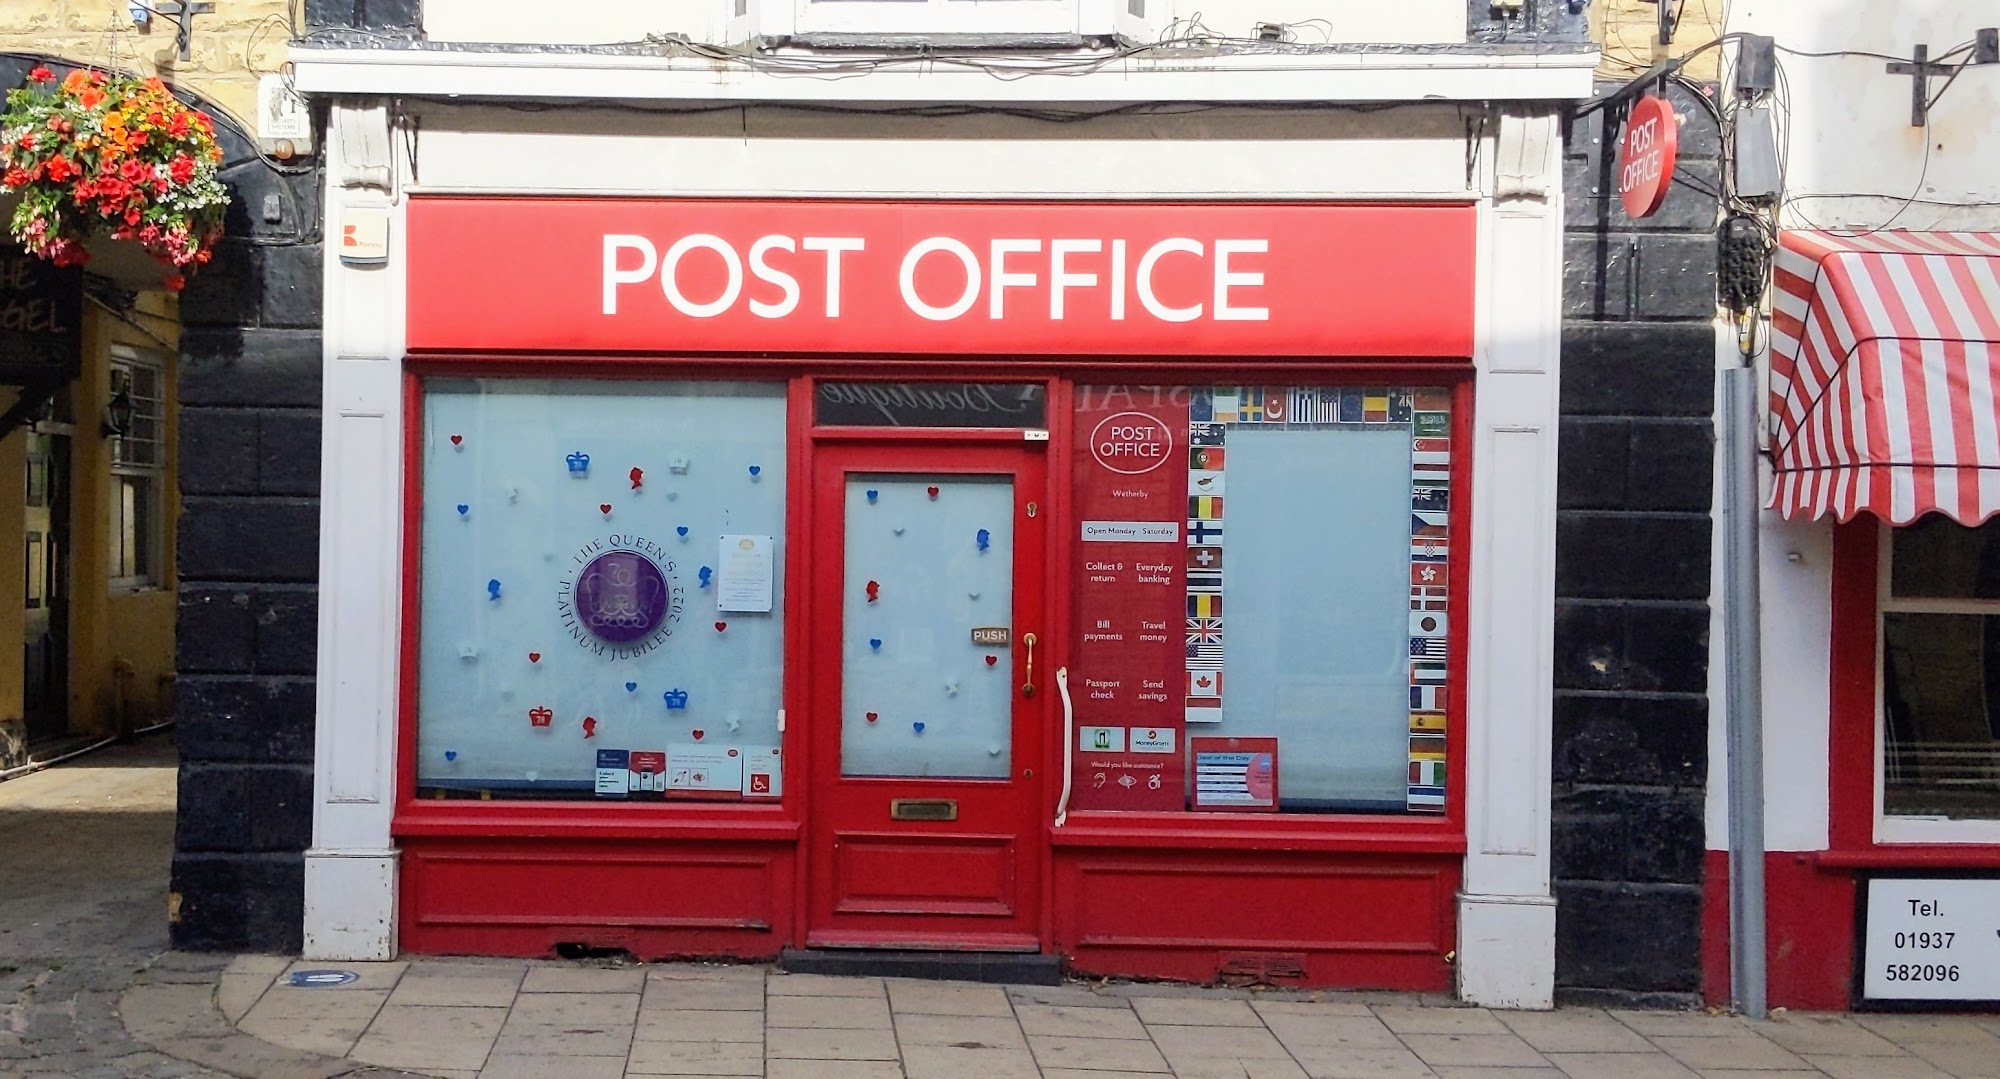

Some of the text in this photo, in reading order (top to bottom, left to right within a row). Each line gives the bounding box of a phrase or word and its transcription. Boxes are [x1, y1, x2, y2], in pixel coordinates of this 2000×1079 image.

[1629, 116, 1658, 158] POST
[1623, 149, 1659, 193] OFFICE
[602, 233, 1269, 323] POST OFFICE
[1111, 426, 1155, 441] POST
[1100, 442, 1160, 457] OFFICE
[1112, 489, 1148, 499] Wetherby
[1086, 526, 1174, 536] Open Monday Saturday
[572, 534, 677, 572] THE QUEEN'S
[1085, 562, 1115, 571] Collect
[1136, 562, 1173, 574] Everyday
[1090, 574, 1116, 583] return
[1138, 574, 1171, 585] banking
[557, 580, 684, 662] PLATINUM JUBILEE 2022
[1097, 620, 1110, 629] Bill
[1142, 621, 1166, 630] Travel
[974, 630, 1007, 640] PUSH
[1084, 633, 1123, 642] payments
[1140, 634, 1167, 643] money
[1086, 679, 1120, 689] Passport
[1143, 680, 1164, 689] Send
[1091, 690, 1114, 699] check
[1139, 692, 1168, 702] savings
[1908, 899, 1944, 916] Tel.
[1894, 932, 1955, 949] 01937
[1886, 964, 1959, 982] 582096
